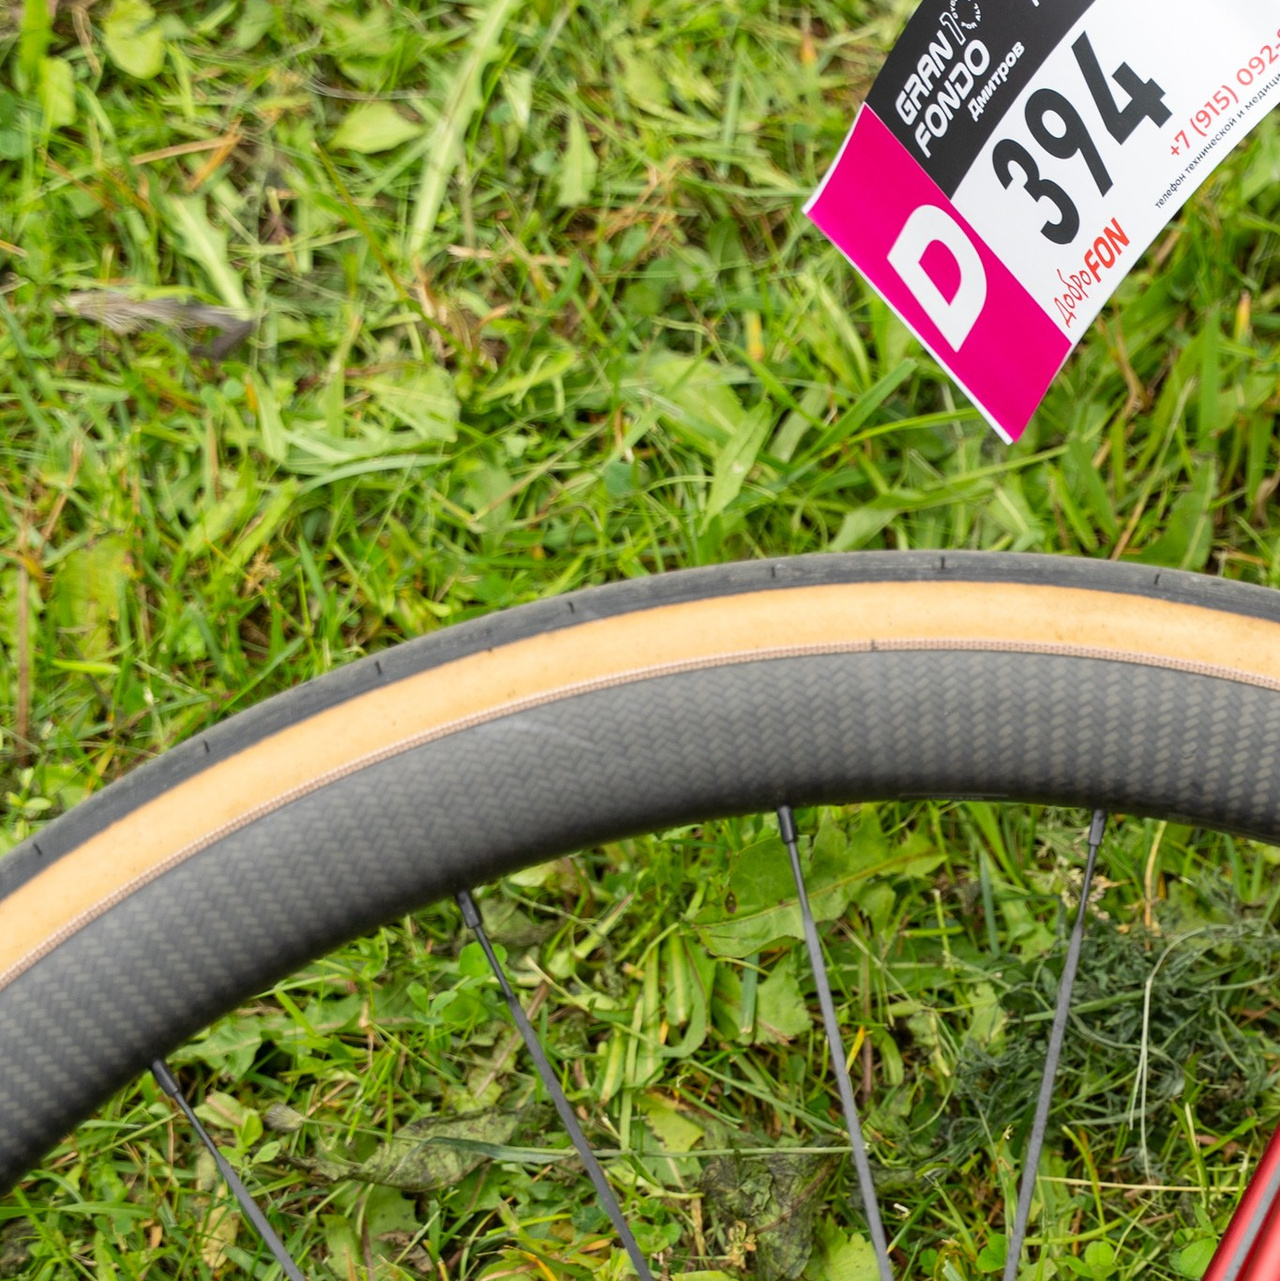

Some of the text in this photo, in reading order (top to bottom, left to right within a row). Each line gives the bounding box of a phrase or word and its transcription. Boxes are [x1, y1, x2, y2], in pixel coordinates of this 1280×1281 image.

[894, 29, 954, 126] GRAN
[914, 39, 991, 159] FONDO
[966, 40, 1026, 123] Дмитров
[1169, 129, 1192, 157] +7
[1189, 84, 1240, 138] (915)
[991, 29, 1174, 246] 394
[1154, 172, 1187, 210] телефон
[1184, 117, 1238, 175] технической
[1237, 108, 1246, 120] и
[886, 203, 988, 354] D
